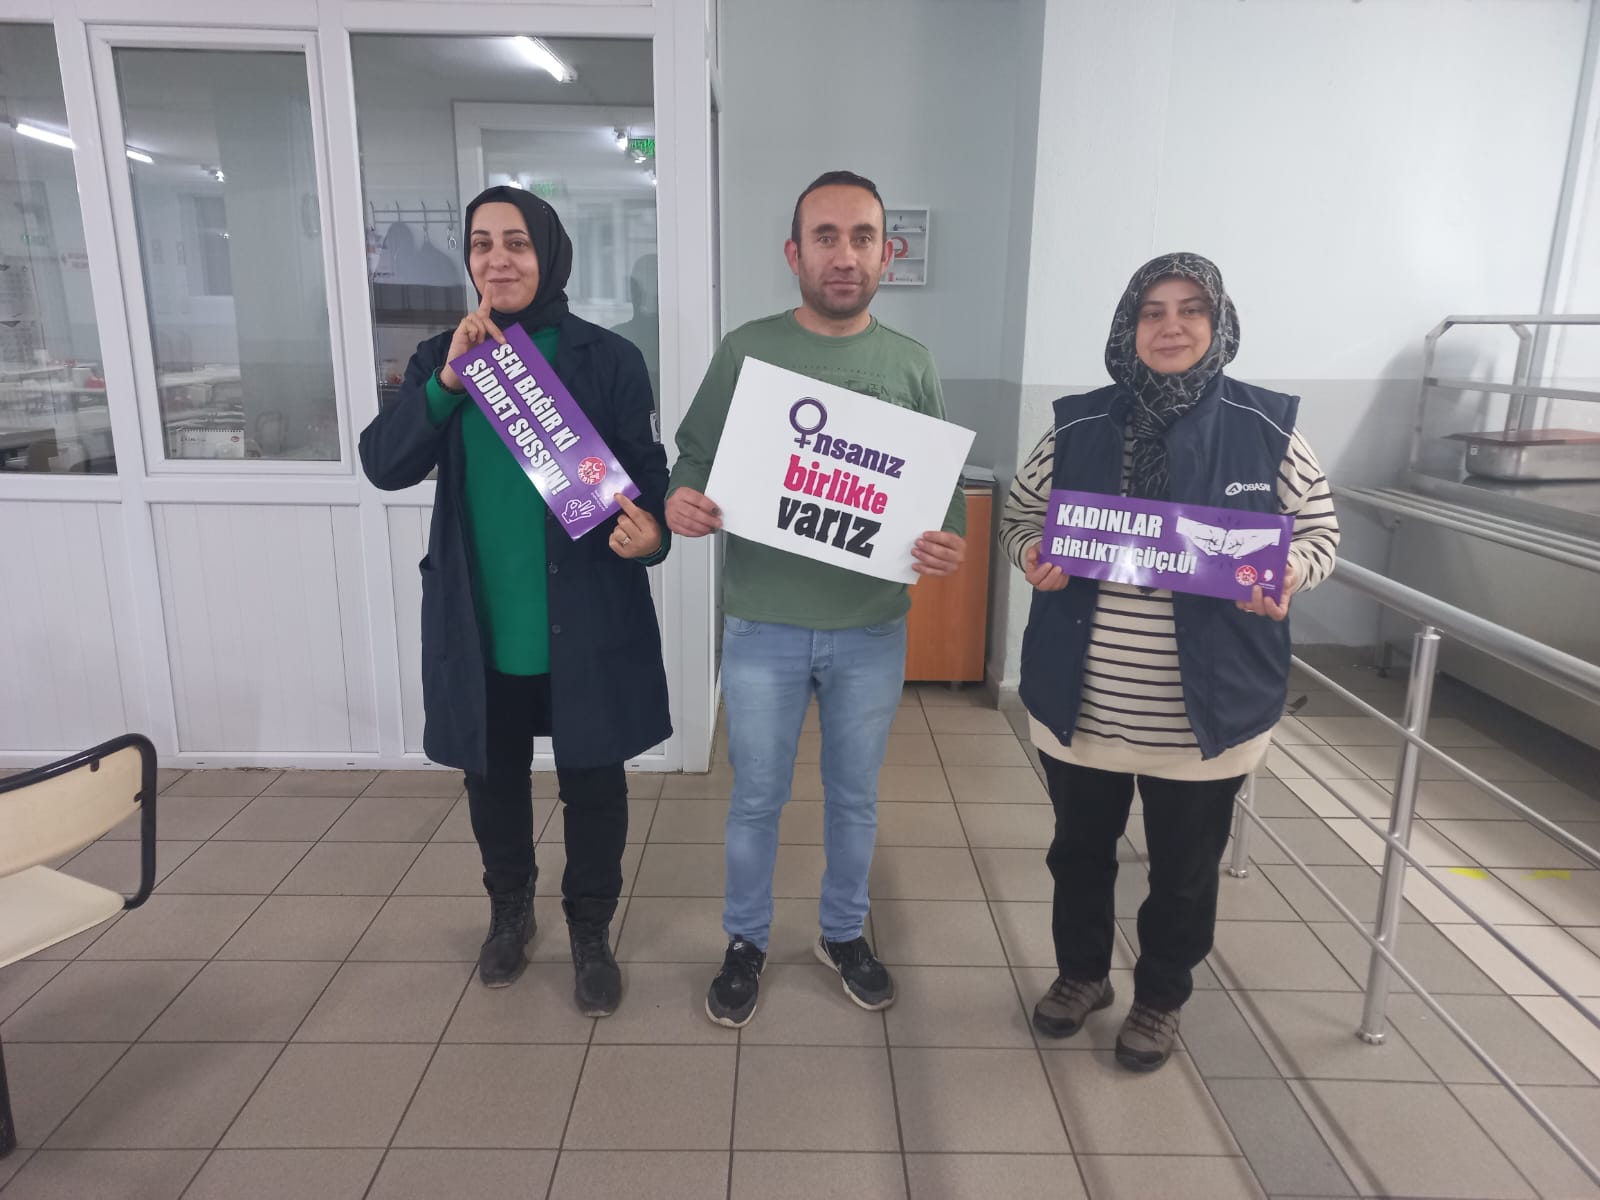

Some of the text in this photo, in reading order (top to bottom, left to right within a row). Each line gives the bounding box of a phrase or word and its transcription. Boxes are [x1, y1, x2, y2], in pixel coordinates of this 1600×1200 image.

[462, 358, 571, 496] ŞİDDET SUSSUN!
[491, 343, 581, 453] SEN BAĞIR Kİ
[783, 453, 888, 515] birlikte
[776, 496, 882, 559] varız
[1056, 503, 1163, 538] KADINLAR
[1131, 546, 1198, 575] GÜÇLÜ!
